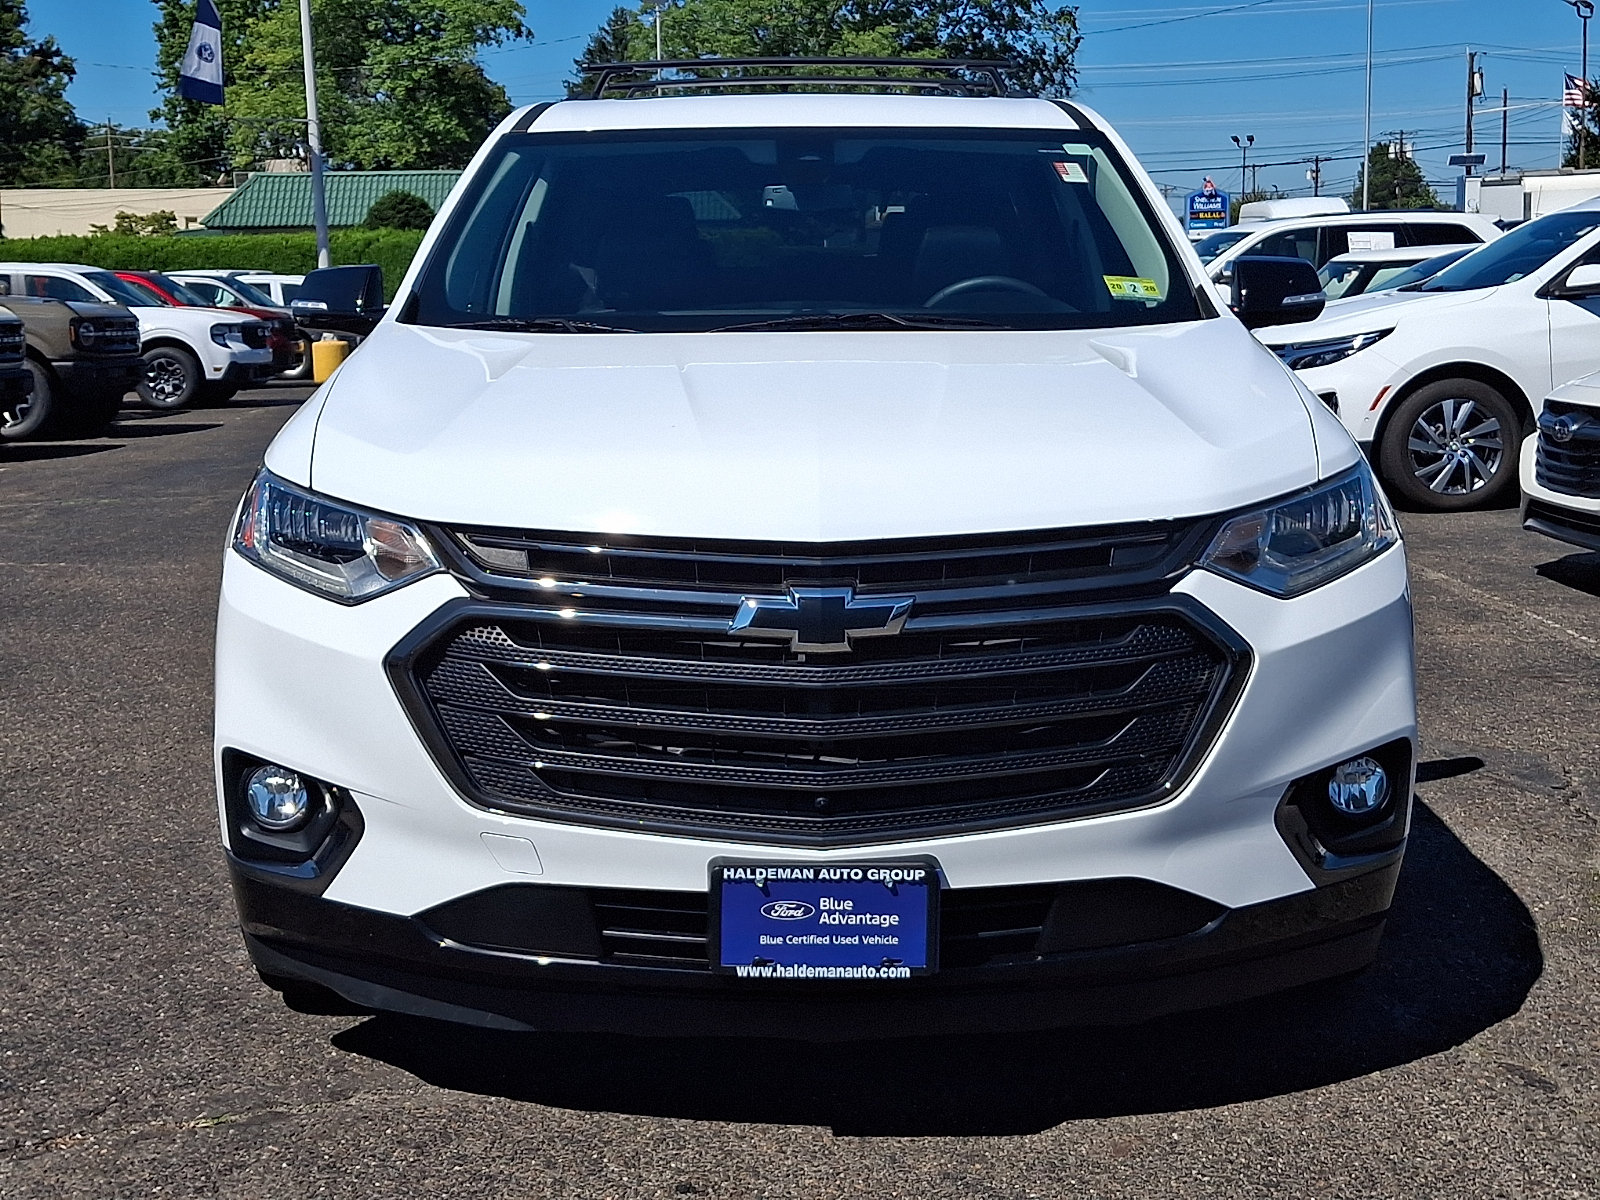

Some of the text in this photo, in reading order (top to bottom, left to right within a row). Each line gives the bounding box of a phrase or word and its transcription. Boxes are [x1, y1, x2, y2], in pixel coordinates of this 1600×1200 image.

[1129, 283, 1138, 293] 2
[723, 867, 926, 881] HALDEMAN AUTO GROUP
[770, 902, 805, 917] Ford
[819, 897, 854, 911] Blue
[818, 911, 900, 928] Advantage
[759, 934, 899, 945] Blue Certified Used Vehicle
[735, 963, 911, 979] www.haldemanauto.com
